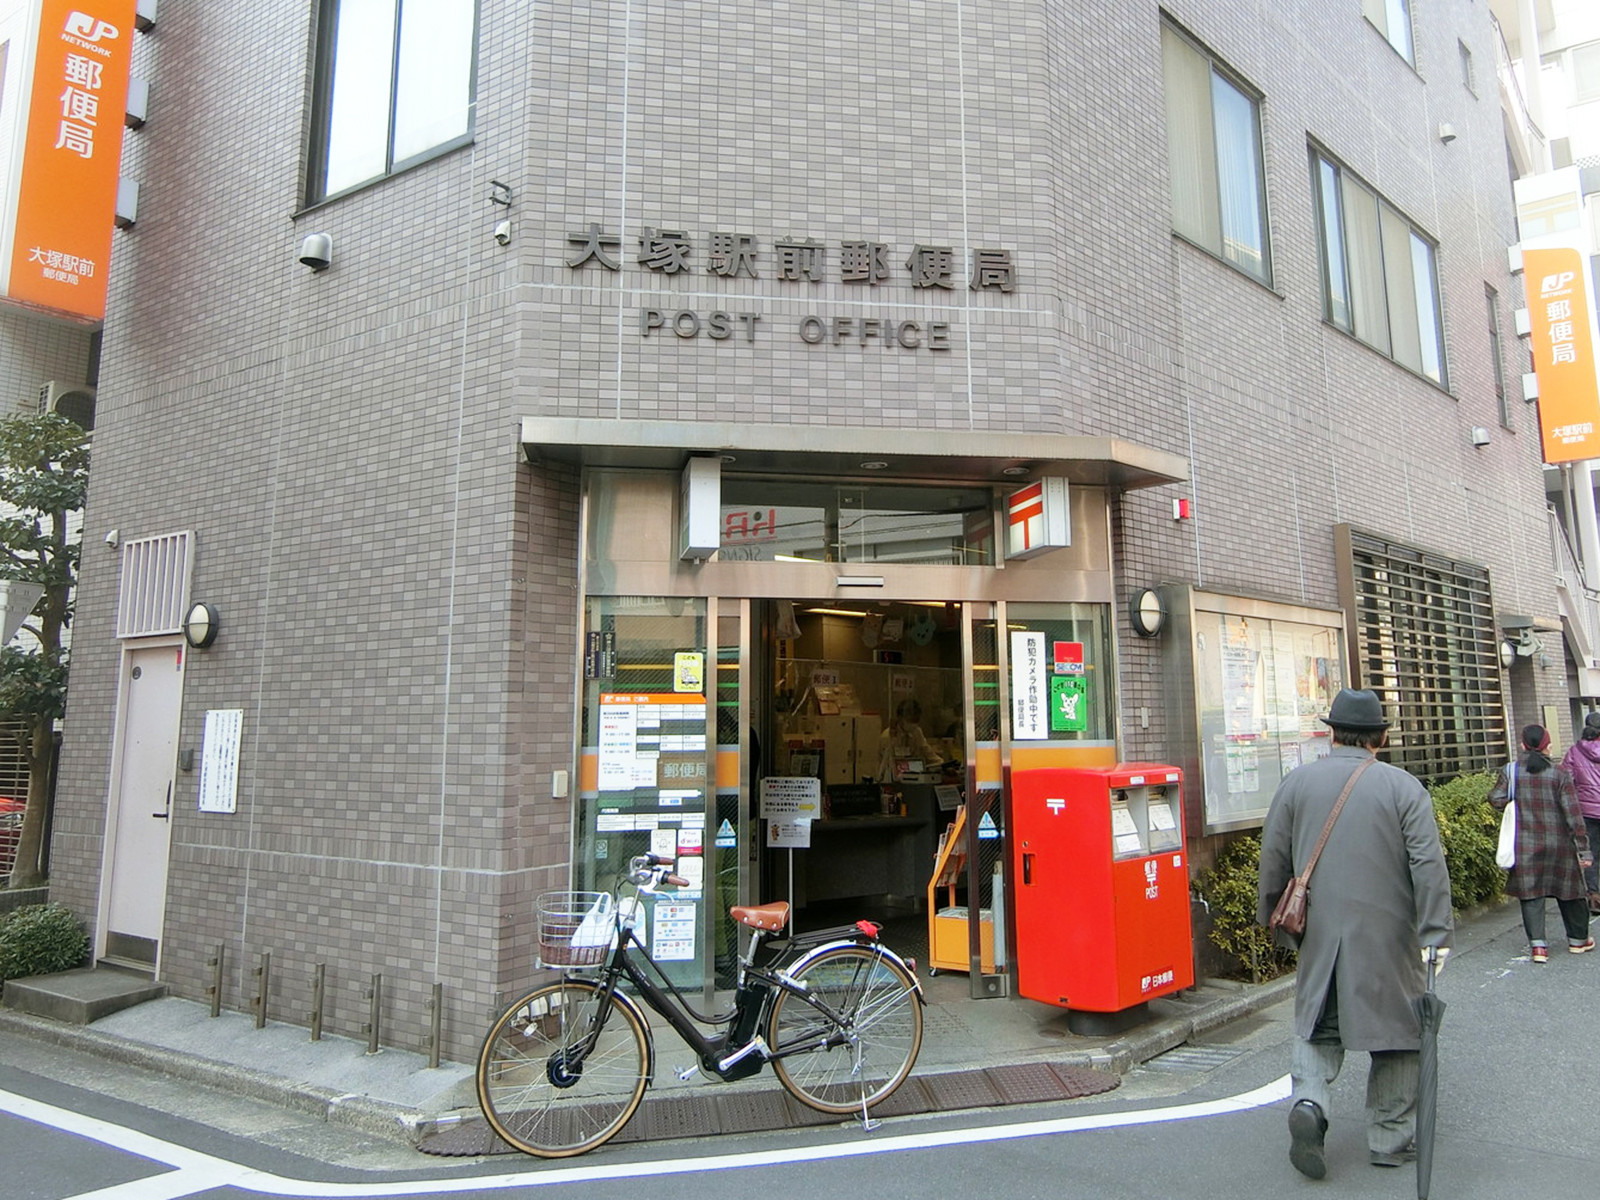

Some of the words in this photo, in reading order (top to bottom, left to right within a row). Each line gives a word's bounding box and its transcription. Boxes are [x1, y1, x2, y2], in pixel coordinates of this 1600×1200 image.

[61, 33, 112, 58] NETWORK
[55, 53, 104, 159] 郵便局
[28, 246, 96, 278] 大塚駅前
[565, 221, 1018, 293] 大塚駅前郵便局
[42, 267, 79, 286] 郵便局
[640, 307, 761, 343] POST
[799, 314, 952, 351] OFFICE
[1547, 300, 1576, 366] 郵便局
[1552, 422, 1593, 438] 大塚駅前
[1056, 663, 1082, 671] SECOM
[1027, 638, 1038, 733] 防犯カメラ作動中です
[664, 762, 706, 778] 郵便局
[1144, 859, 1158, 875] 郵便
[1145, 885, 1159, 900] POST
